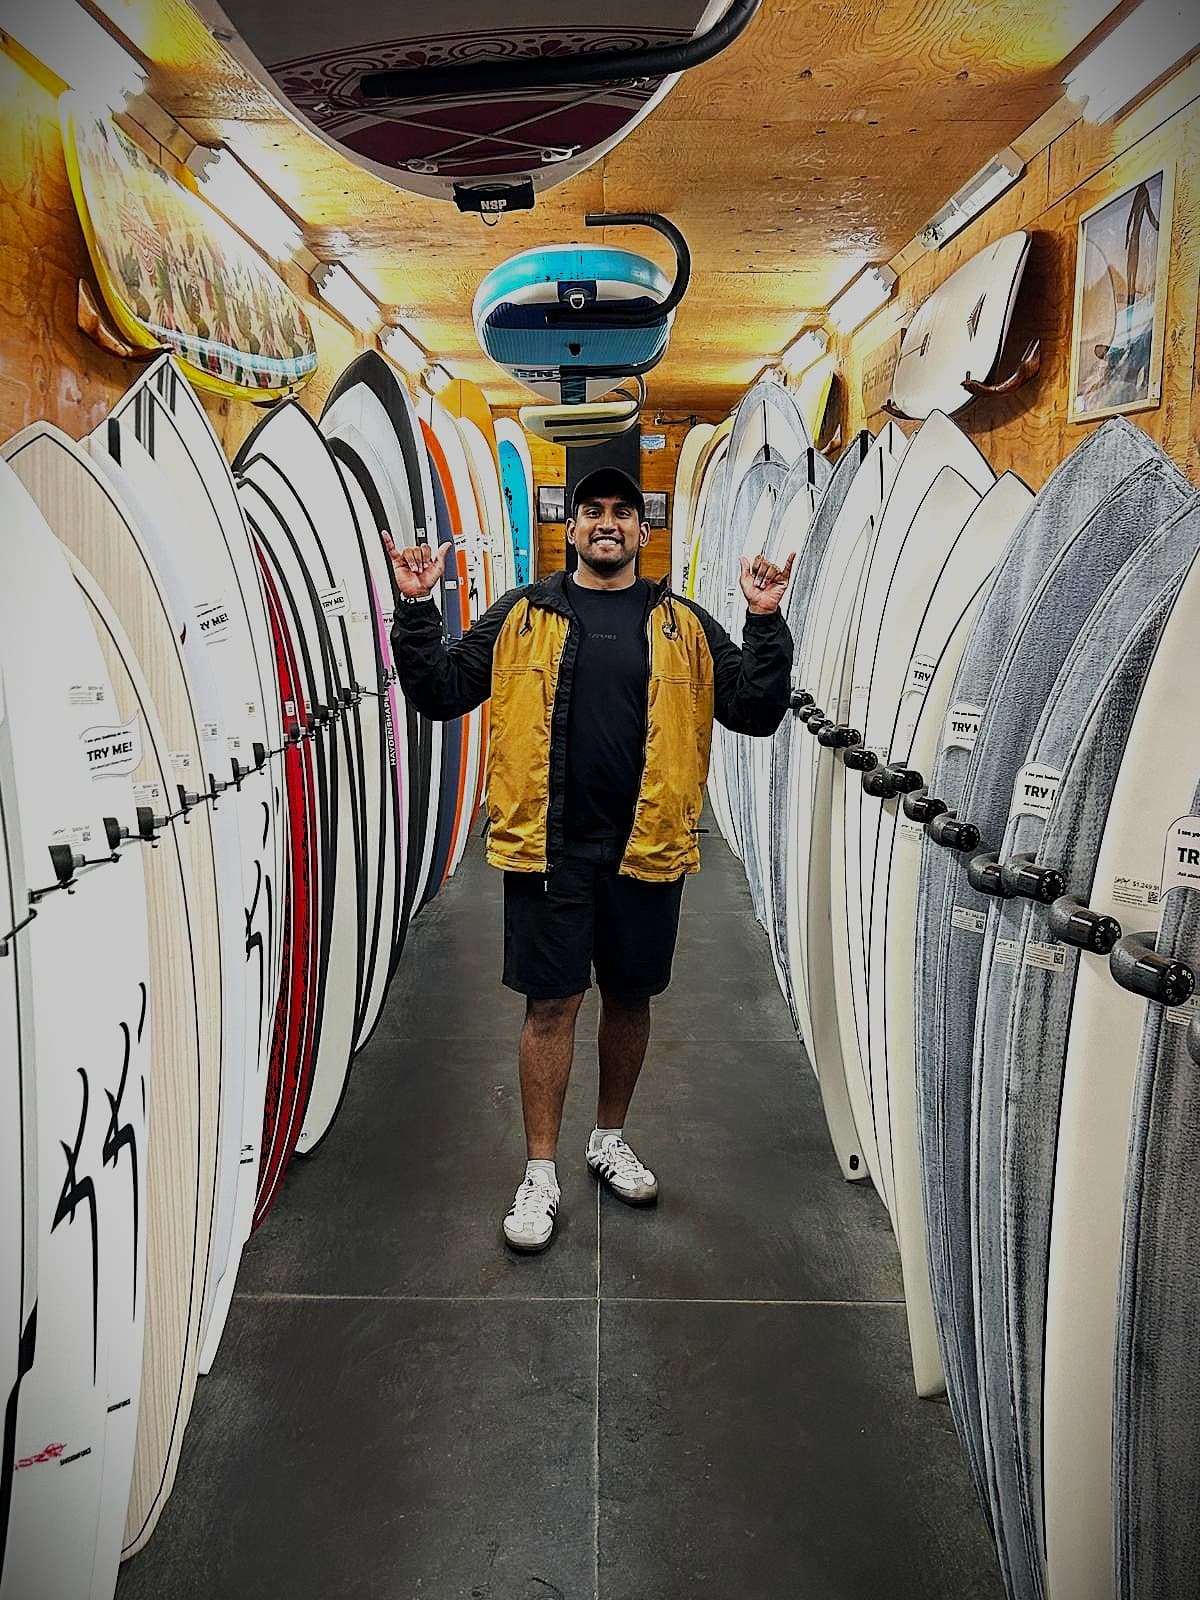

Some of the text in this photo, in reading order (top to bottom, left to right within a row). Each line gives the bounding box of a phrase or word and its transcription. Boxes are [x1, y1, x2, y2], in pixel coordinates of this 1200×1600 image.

[480, 199, 507, 210] NSP
[211, 612, 229, 627] ME!
[913, 670, 931, 682] TRY
[951, 721, 972, 733] TRY
[86, 740, 133, 762] TRY ME!
[1024, 784, 1050, 799] TRY
